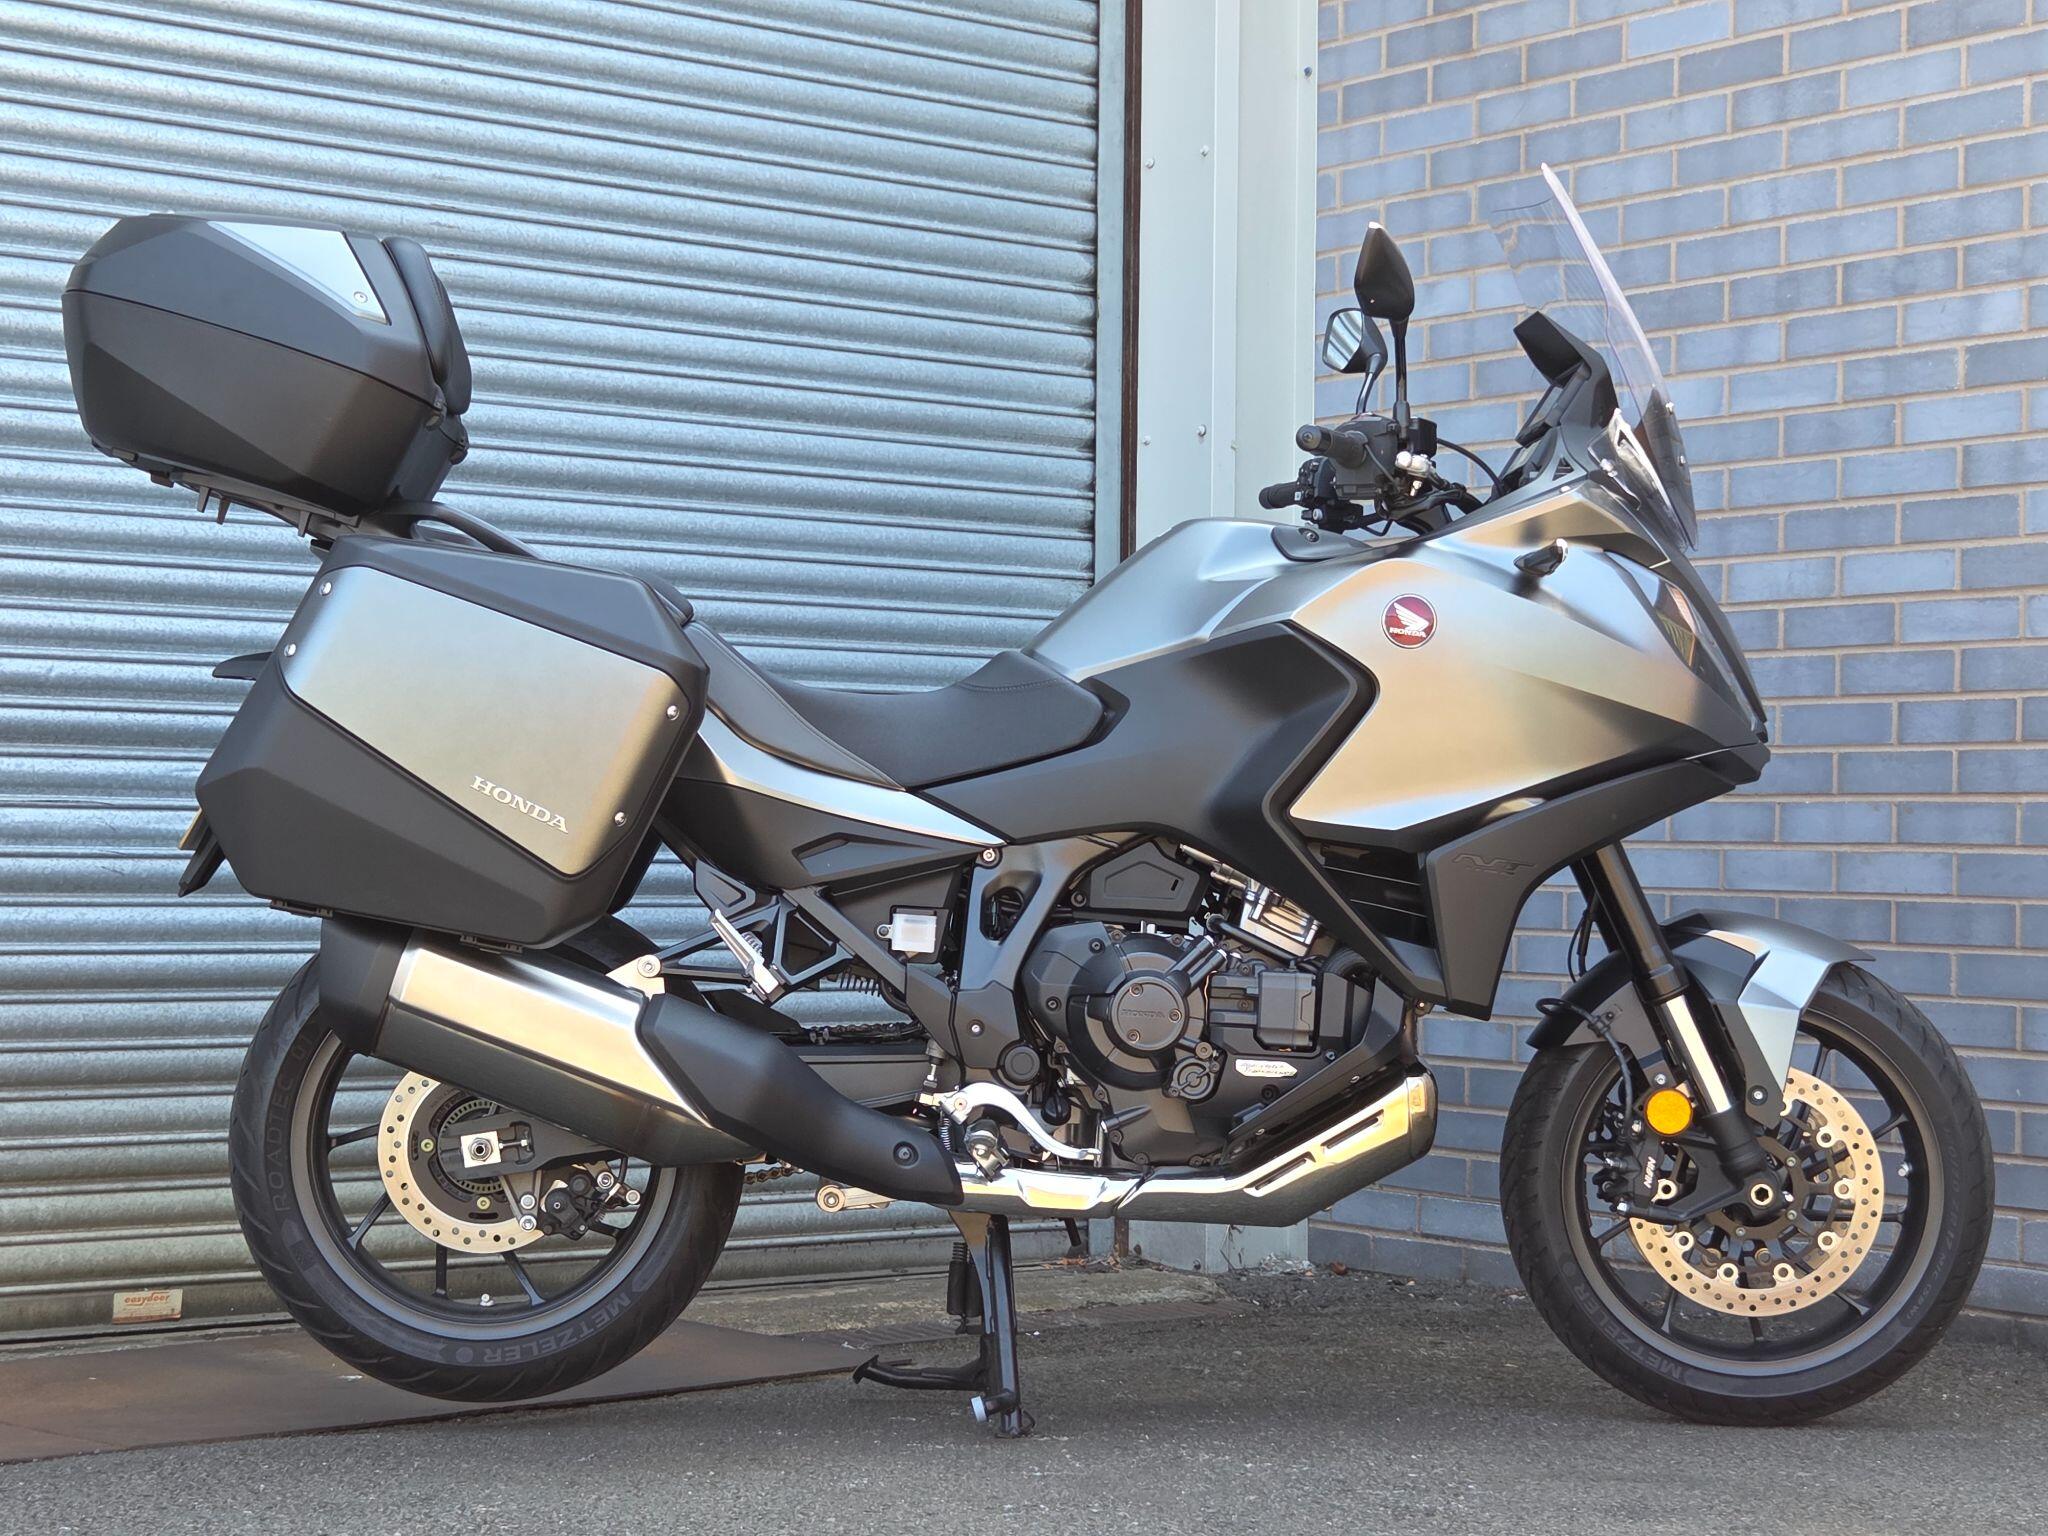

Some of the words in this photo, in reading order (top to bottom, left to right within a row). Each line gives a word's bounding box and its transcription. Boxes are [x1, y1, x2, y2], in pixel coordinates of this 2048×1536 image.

[1389, 627, 1427, 638] HONDA
[470, 775, 569, 834] HONDA
[266, 1077, 294, 1213] ROADTEC
[483, 1293, 632, 1363] METZELER
[1573, 1283, 1682, 1379] METZELER
